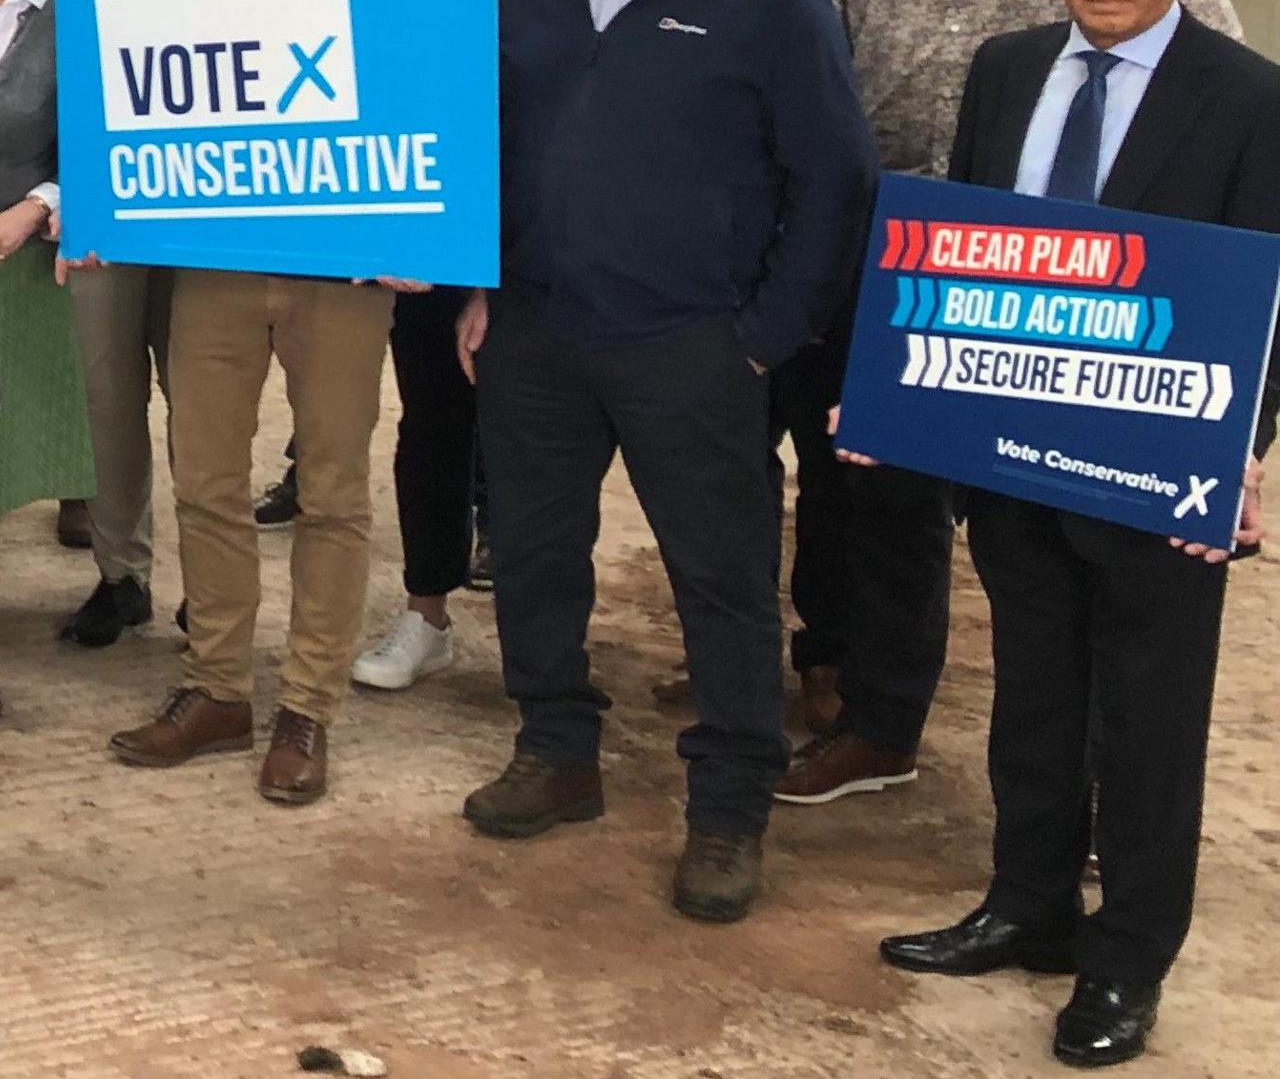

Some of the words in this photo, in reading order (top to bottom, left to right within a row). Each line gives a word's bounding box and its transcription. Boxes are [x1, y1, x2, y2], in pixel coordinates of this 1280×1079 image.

[120, 41, 265, 116] VOTE
[110, 133, 441, 199] CONSERVATIVE
[932, 228, 1023, 274] CLEAR
[1028, 233, 1111, 280] PLAN
[944, 287, 1021, 330] BOLD
[1025, 291, 1139, 342] ACTION
[956, 347, 1069, 395] SECURE
[1075, 359, 1197, 409] FUTURE
[996, 437, 1040, 464] Vote
[1044, 450, 1179, 497] Conservative
